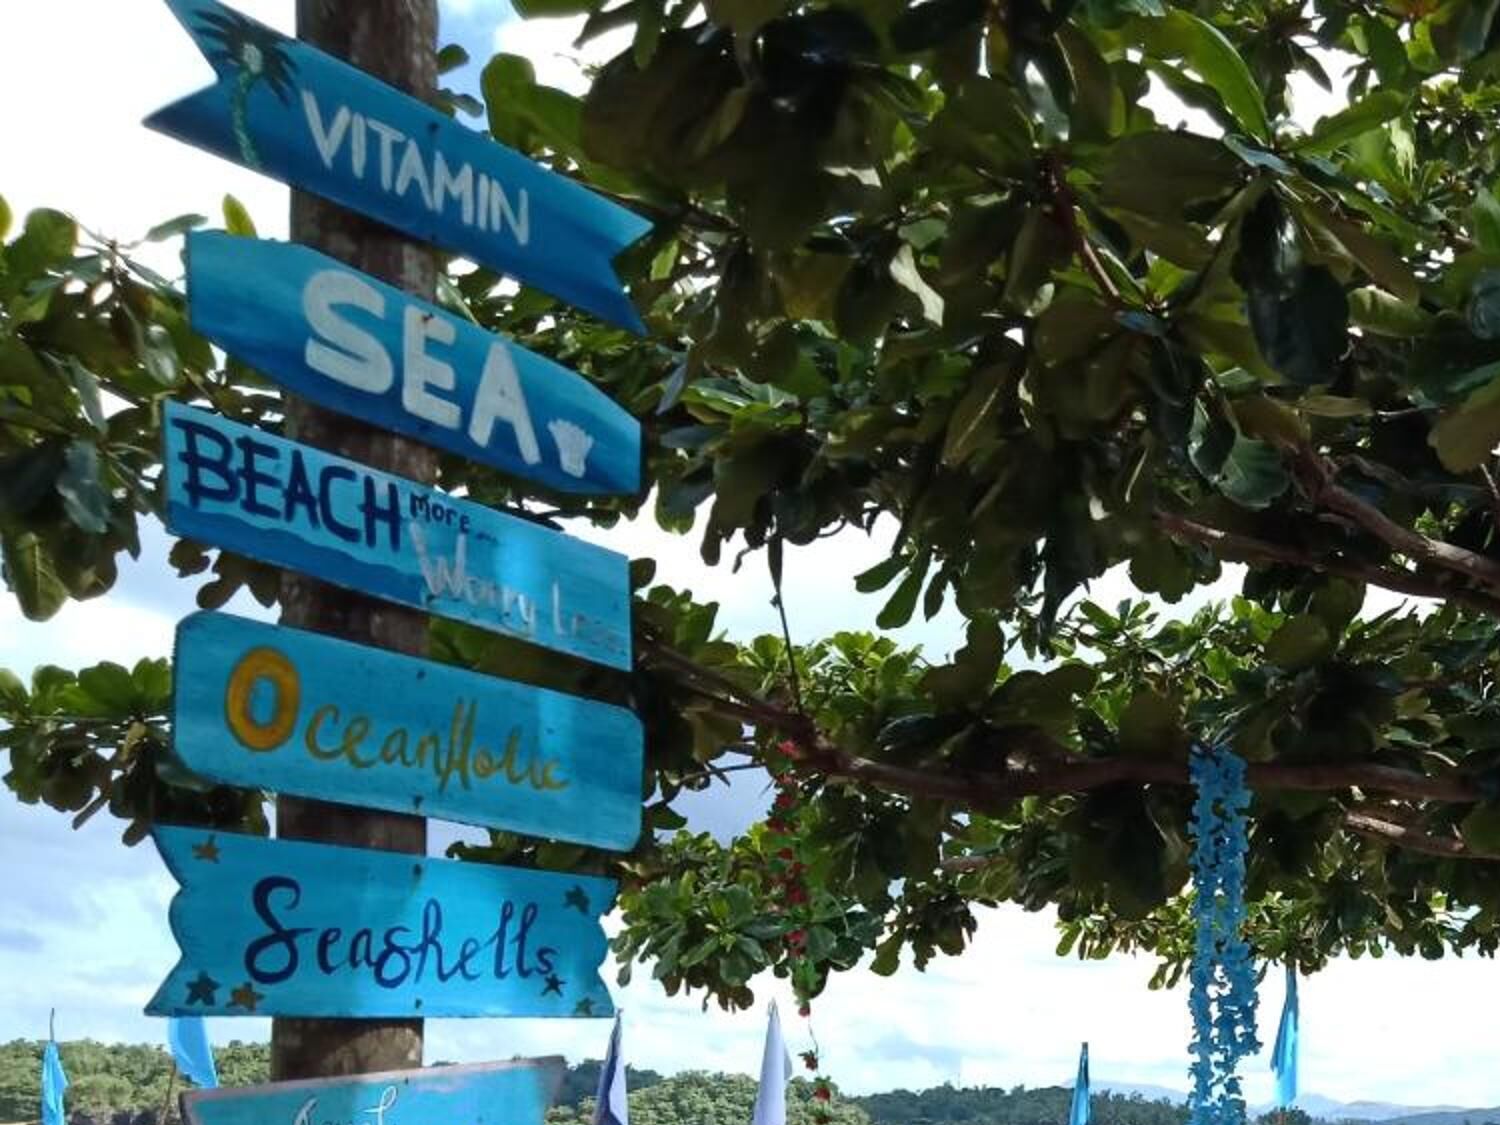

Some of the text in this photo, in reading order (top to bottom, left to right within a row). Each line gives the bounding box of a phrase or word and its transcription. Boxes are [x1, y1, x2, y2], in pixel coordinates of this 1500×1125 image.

[302, 90, 530, 246] VITAMIN
[304, 270, 540, 465] SEA
[171, 417, 400, 552] BEACH
